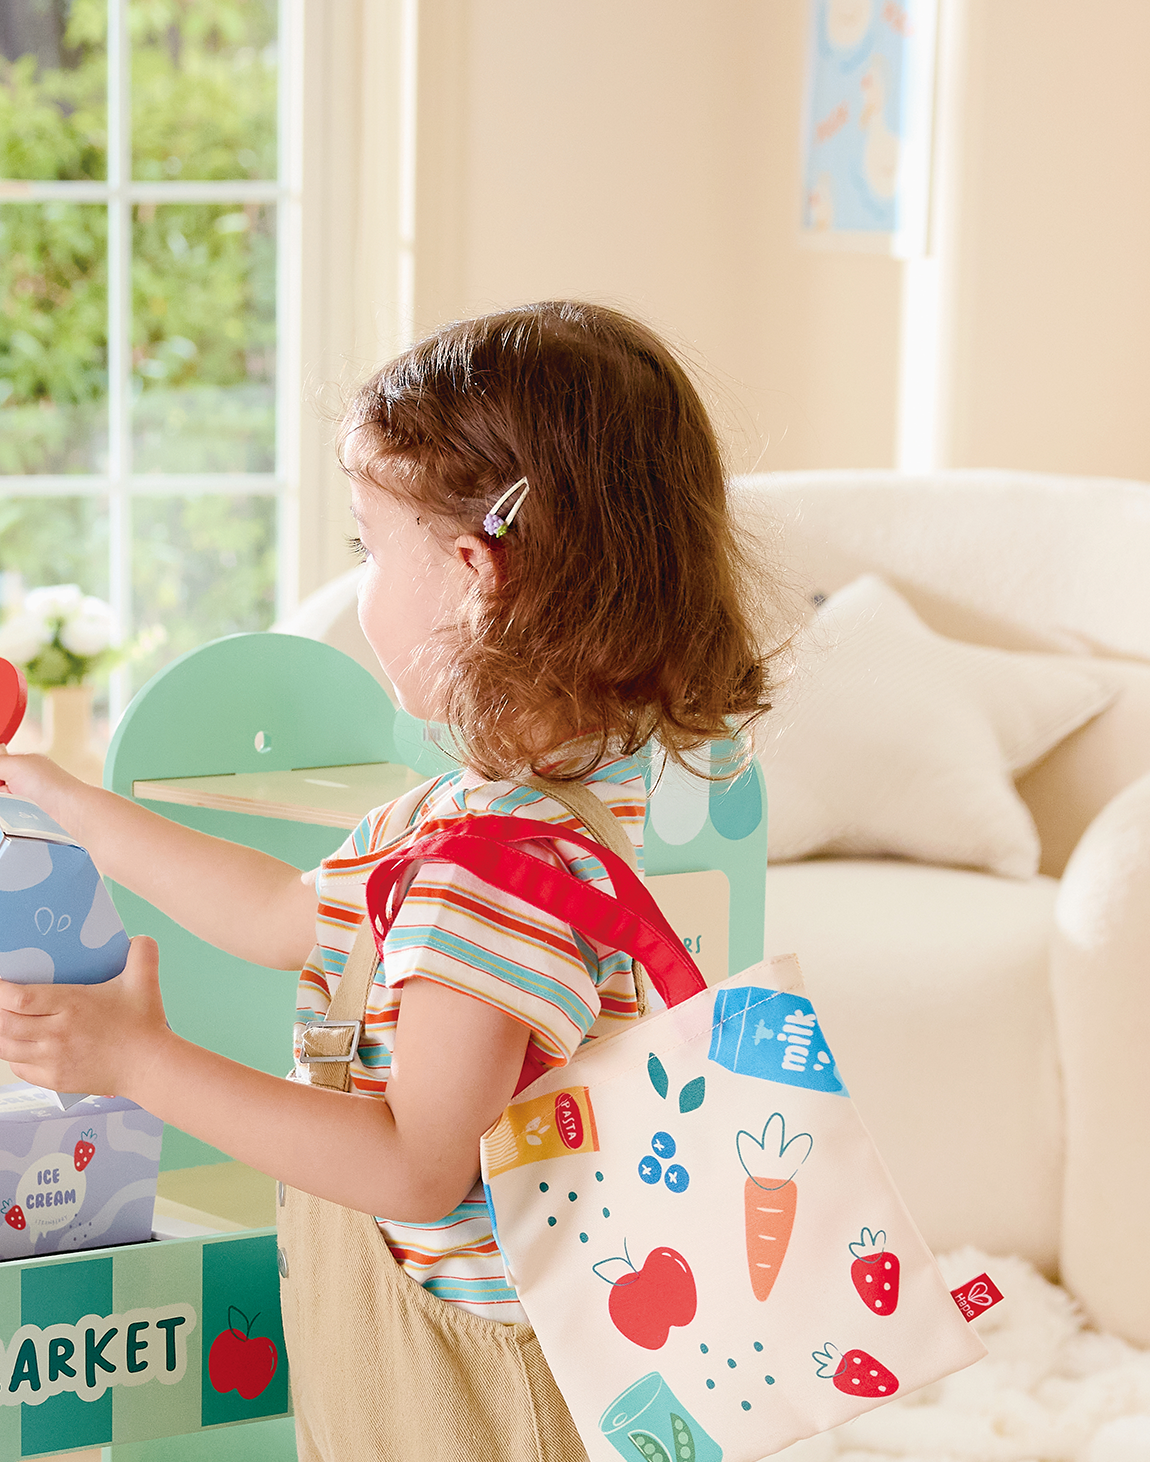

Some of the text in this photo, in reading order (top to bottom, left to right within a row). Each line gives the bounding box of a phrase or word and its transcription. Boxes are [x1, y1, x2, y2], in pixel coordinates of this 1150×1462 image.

[776, 1009, 817, 1072] milk
[561, 1101, 577, 1141] PASTA
[37, 1168, 60, 1186] ICE
[26, 1188, 76, 1210] CREAM
[955, 1293, 975, 1318] Hape
